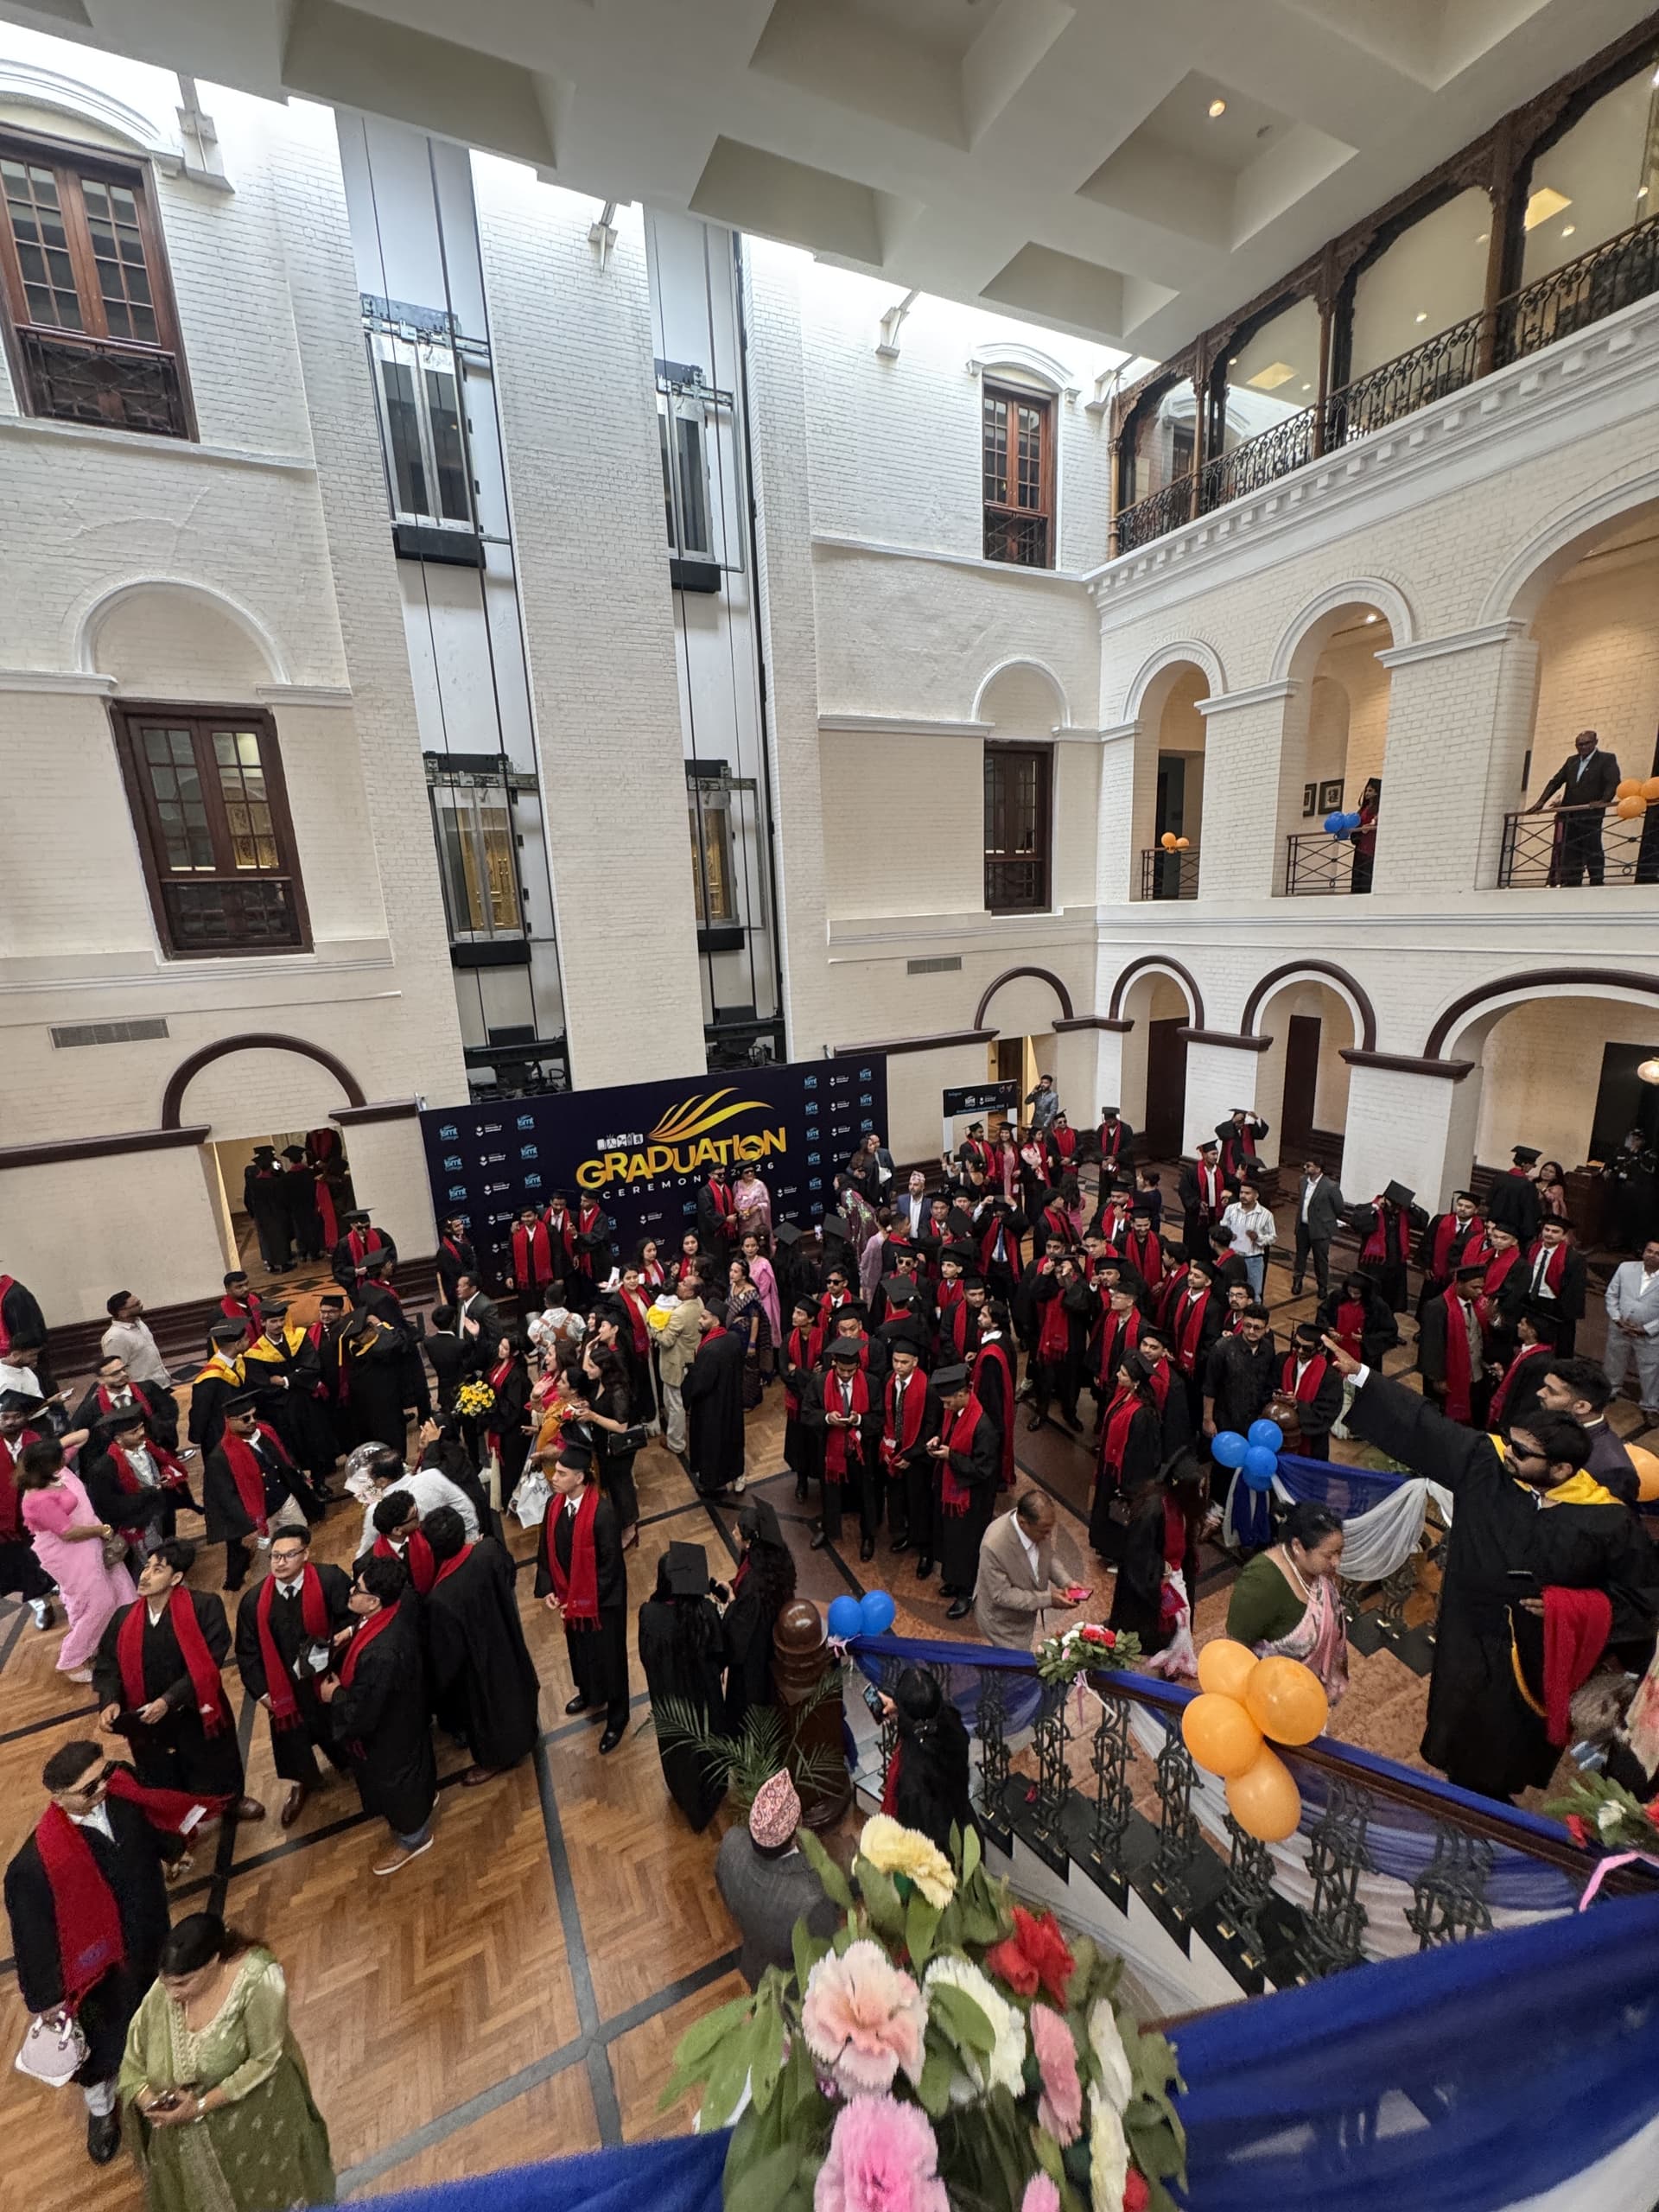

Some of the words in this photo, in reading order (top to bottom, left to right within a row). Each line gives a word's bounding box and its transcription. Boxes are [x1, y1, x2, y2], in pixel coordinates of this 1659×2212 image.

[575, 1127, 786, 1189] GRADUATION
[602, 1175, 702, 1199] CEREMON
[730, 1162, 774, 1176] 226
